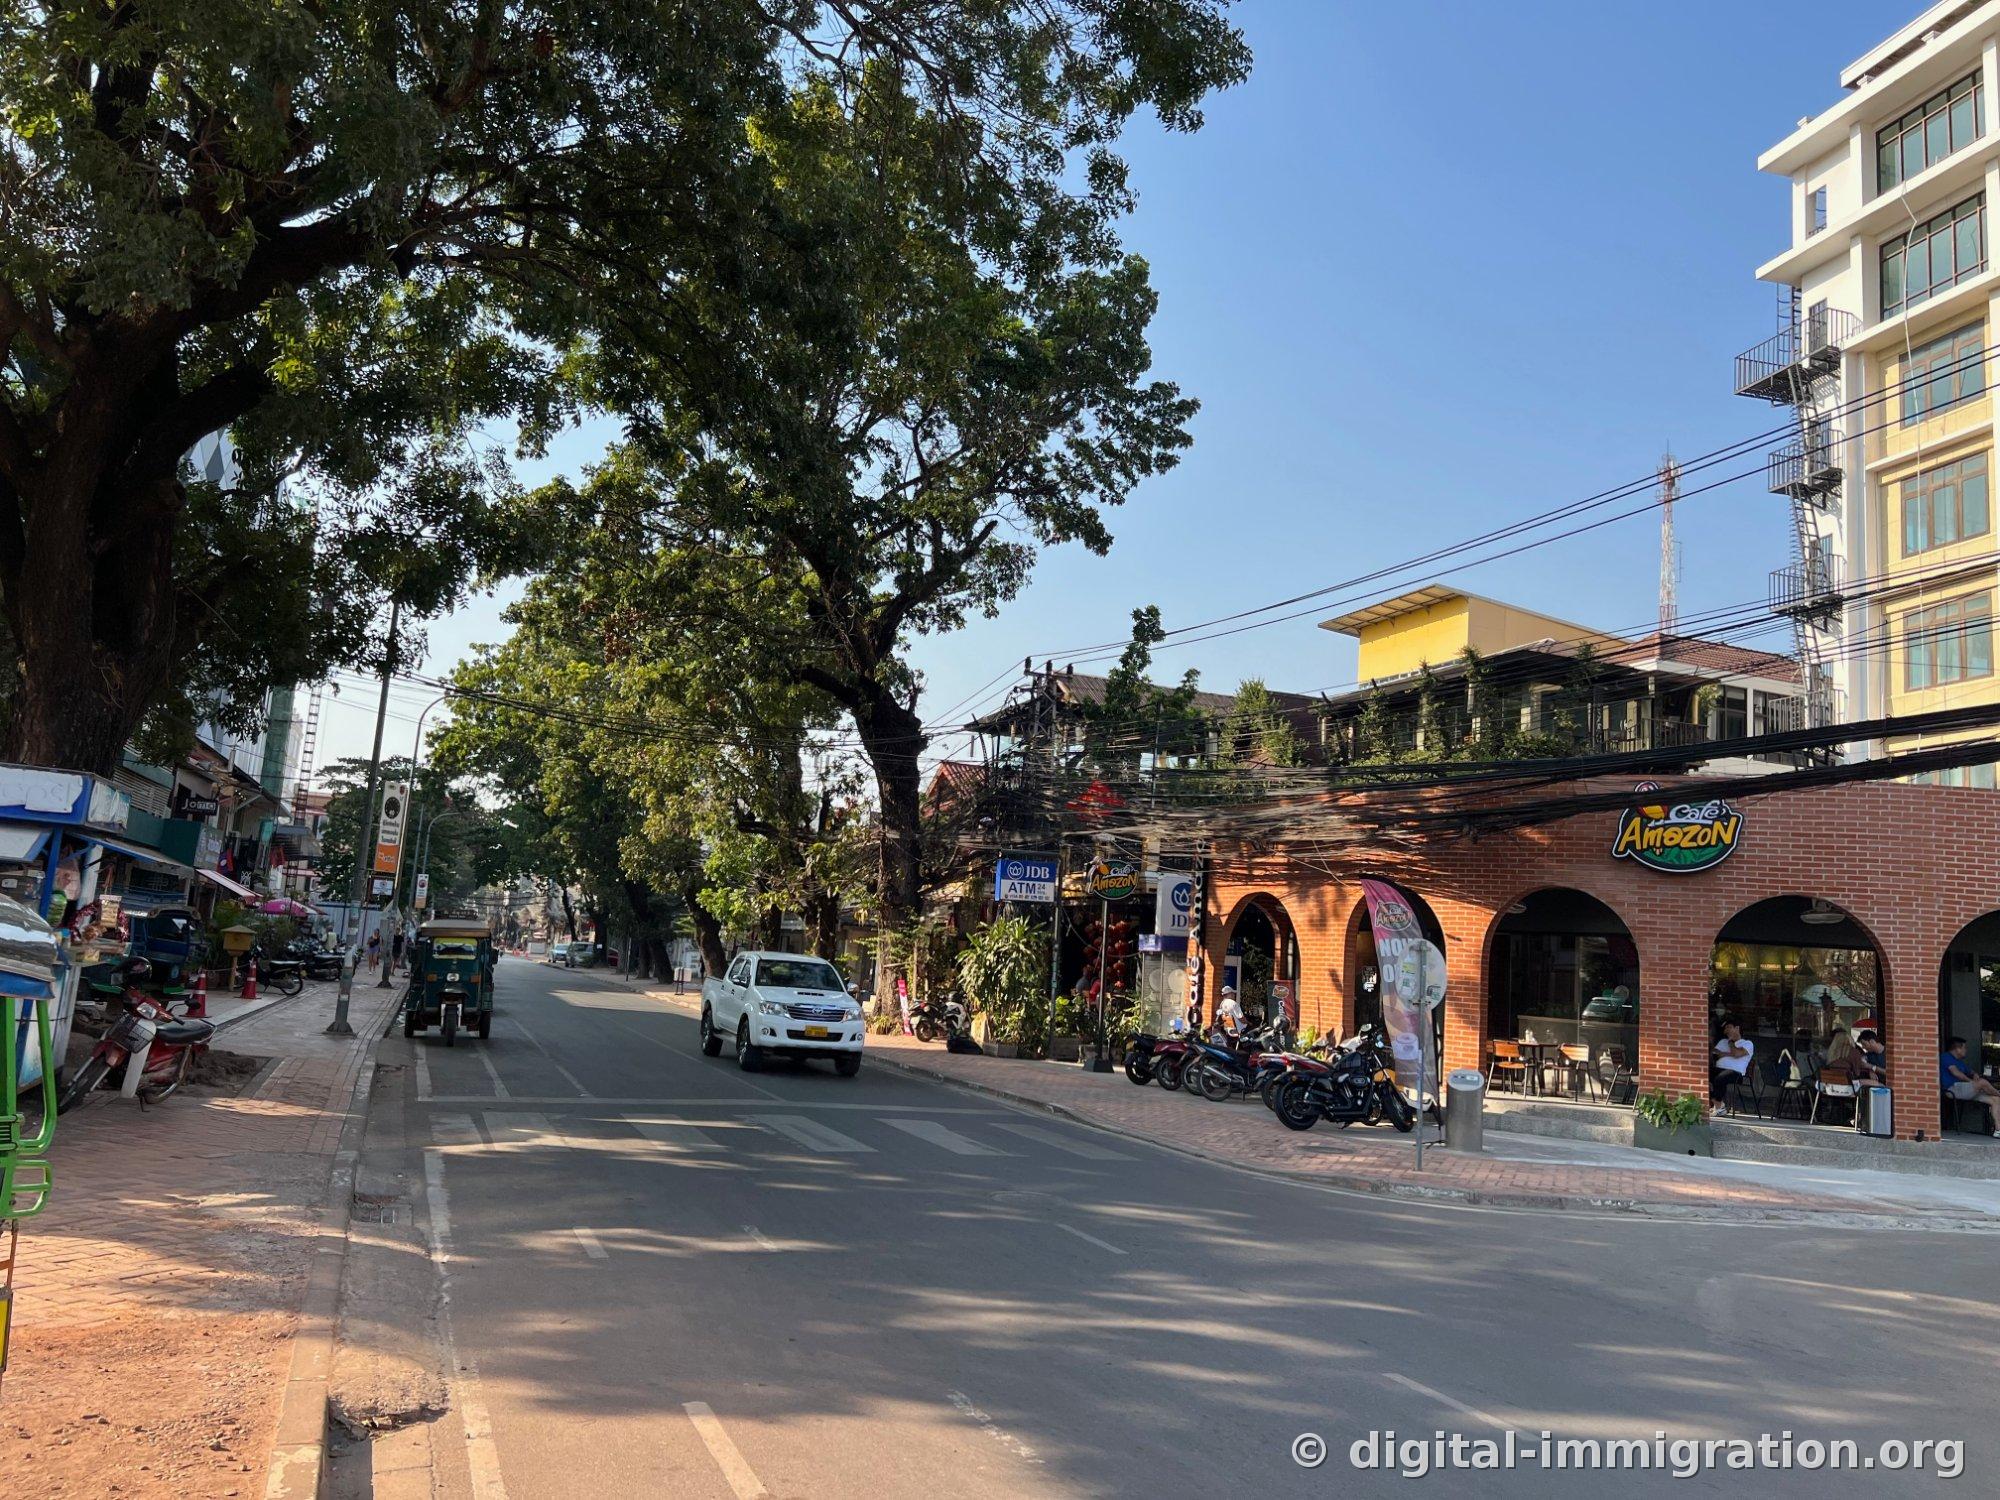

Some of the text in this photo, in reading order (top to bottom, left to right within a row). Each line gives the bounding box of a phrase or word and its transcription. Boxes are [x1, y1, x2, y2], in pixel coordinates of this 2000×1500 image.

[1025, 866, 1050, 879] JDB
[1008, 881, 1036, 894] ATM
[1171, 914, 1188, 927] JD
